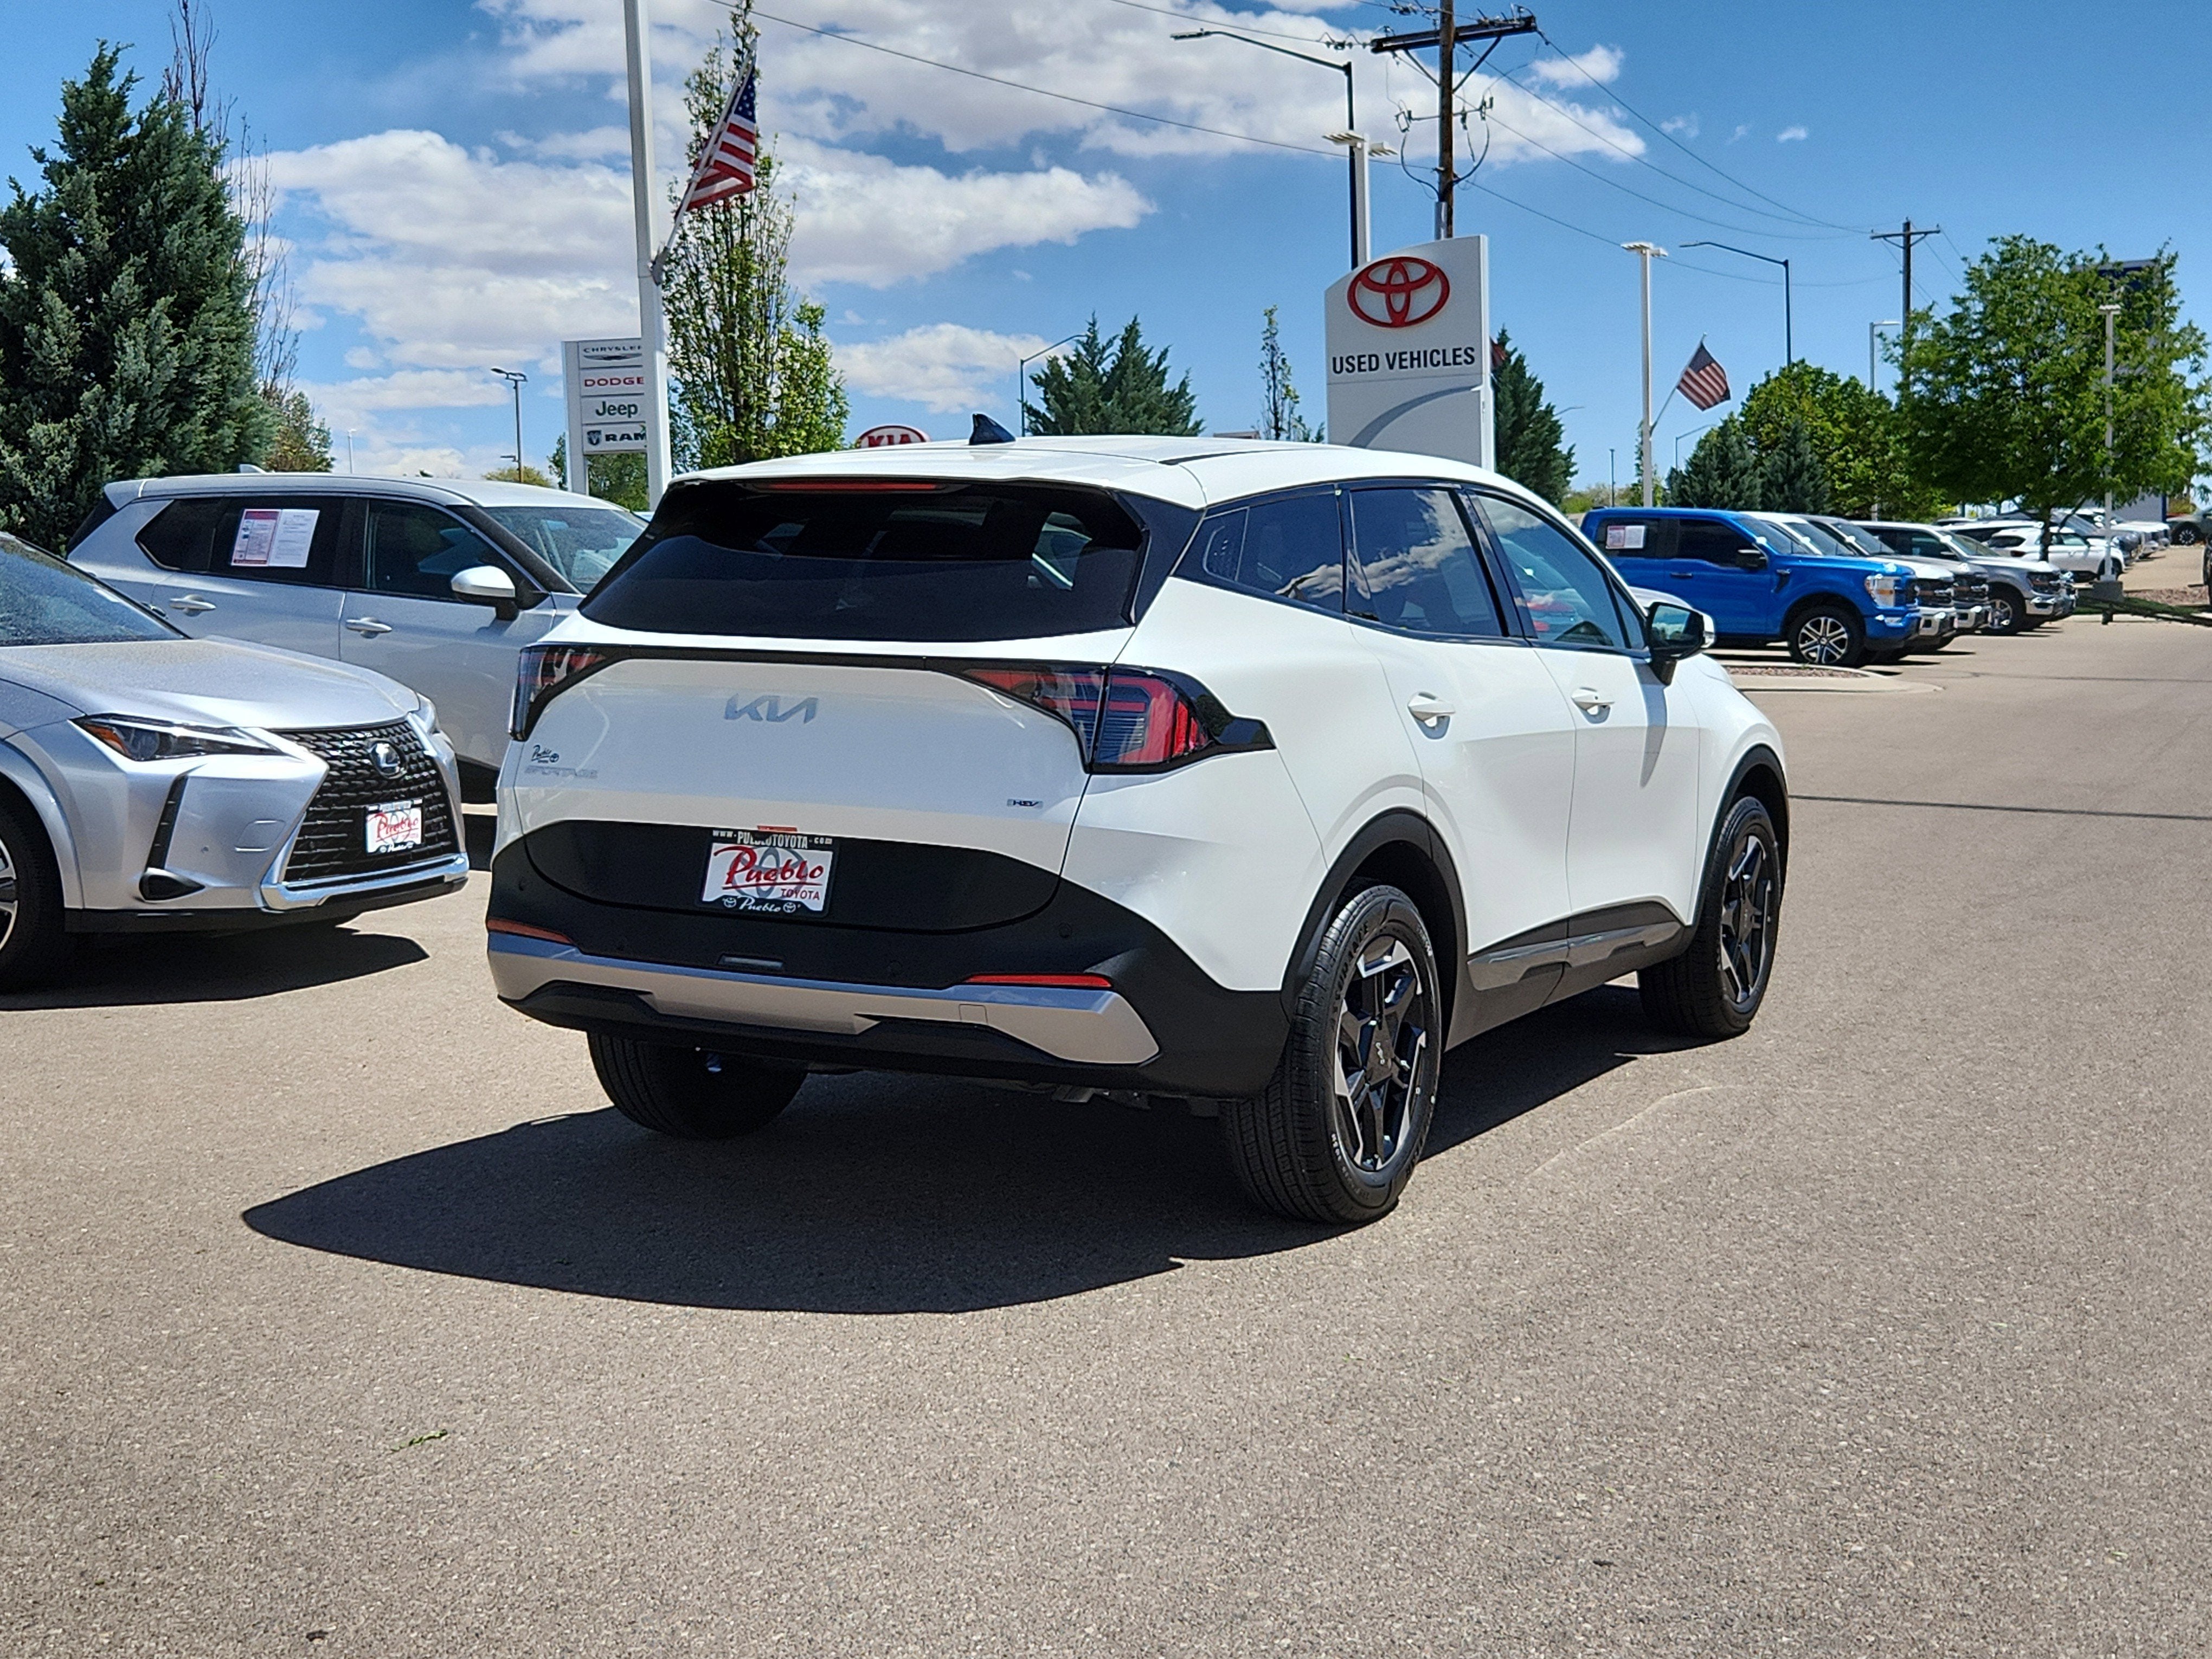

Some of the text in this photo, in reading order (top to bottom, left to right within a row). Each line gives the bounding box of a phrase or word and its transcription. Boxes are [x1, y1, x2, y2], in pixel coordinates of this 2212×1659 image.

[1332, 346, 1475, 374] USED VEHICLES
[584, 376, 645, 387] DODGE
[595, 401, 638, 418] Jeep
[605, 432, 647, 442] RAM
[724, 693, 819, 724] KIA
[713, 846, 824, 885] Pueblo
[781, 888, 820, 901] TOYOTA
[739, 896, 781, 912] Pueblo
